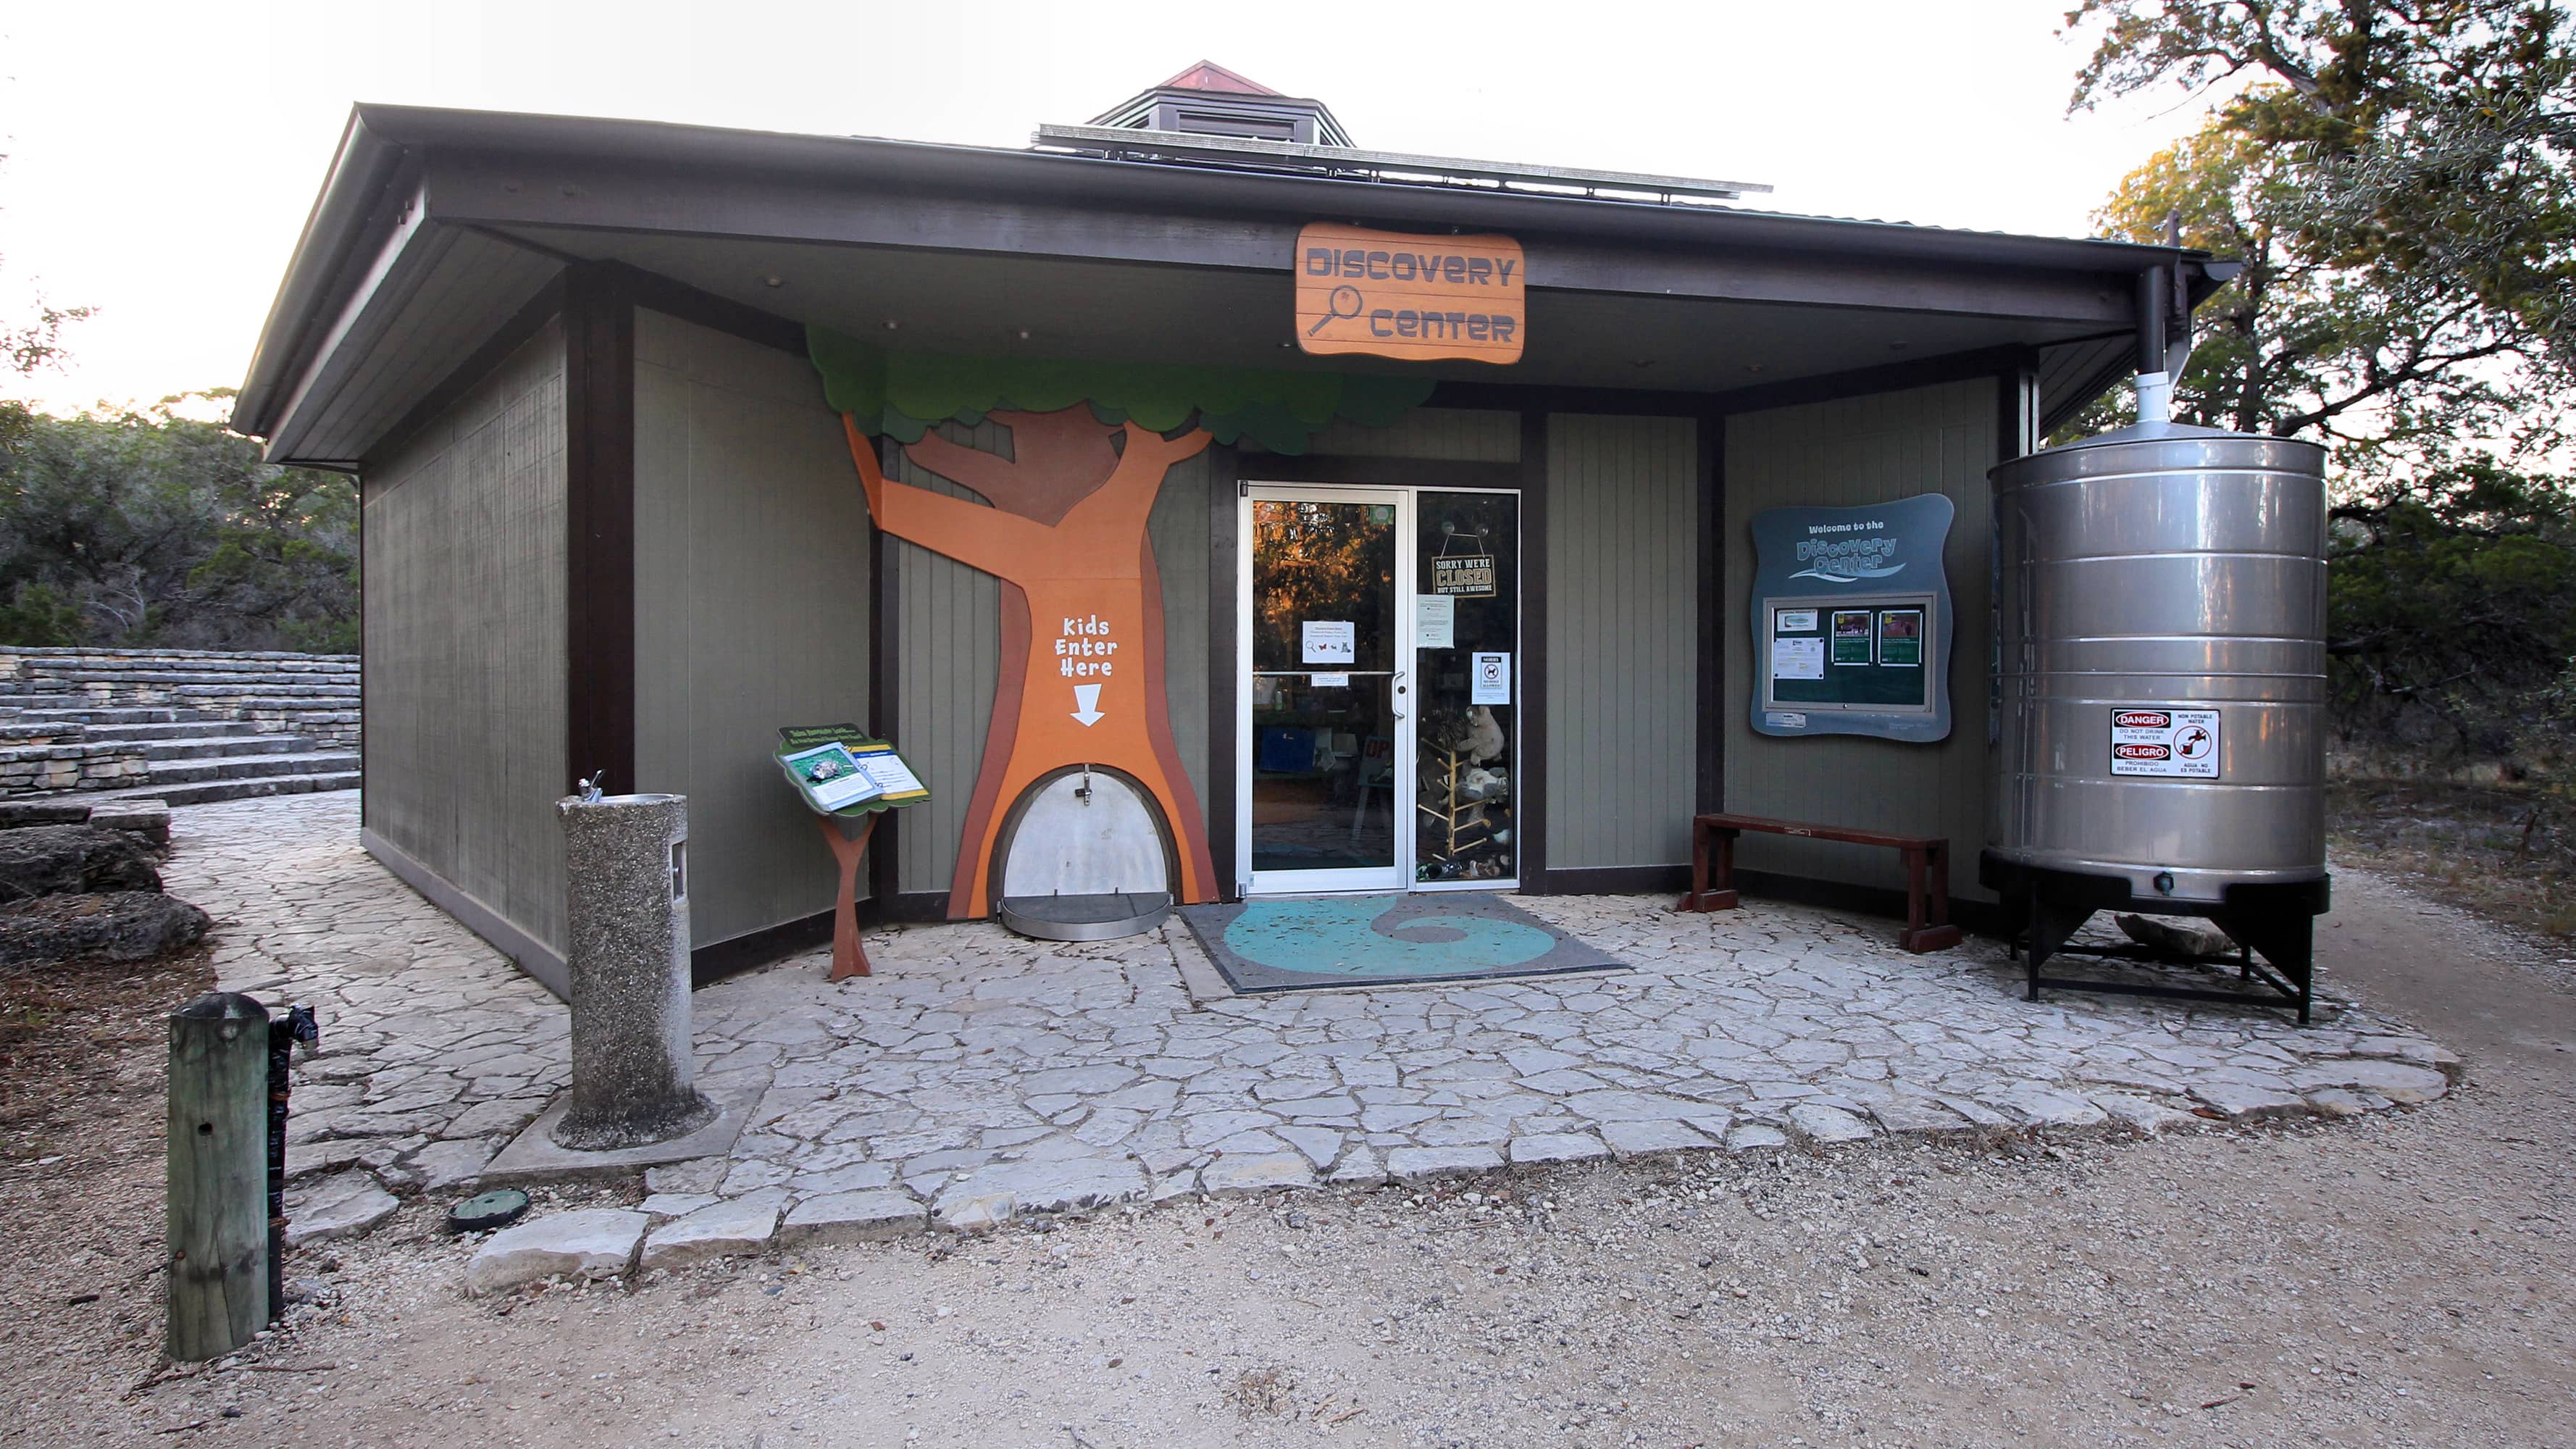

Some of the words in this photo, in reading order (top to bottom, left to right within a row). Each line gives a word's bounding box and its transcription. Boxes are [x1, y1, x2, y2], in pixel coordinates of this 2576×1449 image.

[1306, 247, 1515, 287] DISCOVERY
[1808, 524, 1852, 534] Welcome
[1853, 522, 1865, 531] to
[1866, 520, 1884, 530] the
[1796, 537, 1898, 561] Discovery
[1436, 559, 1462, 569] SORRY
[1813, 552, 1883, 576] Center
[1436, 567, 1492, 587] CLOSED
[1466, 584, 1492, 593] AWESOME
[1063, 614, 1110, 636] Kids
[1054, 637, 1118, 657] Enter
[1060, 656, 1113, 677] Here
[2120, 715, 2165, 724] DANGER
[2119, 747, 2165, 757] PELIGRO
